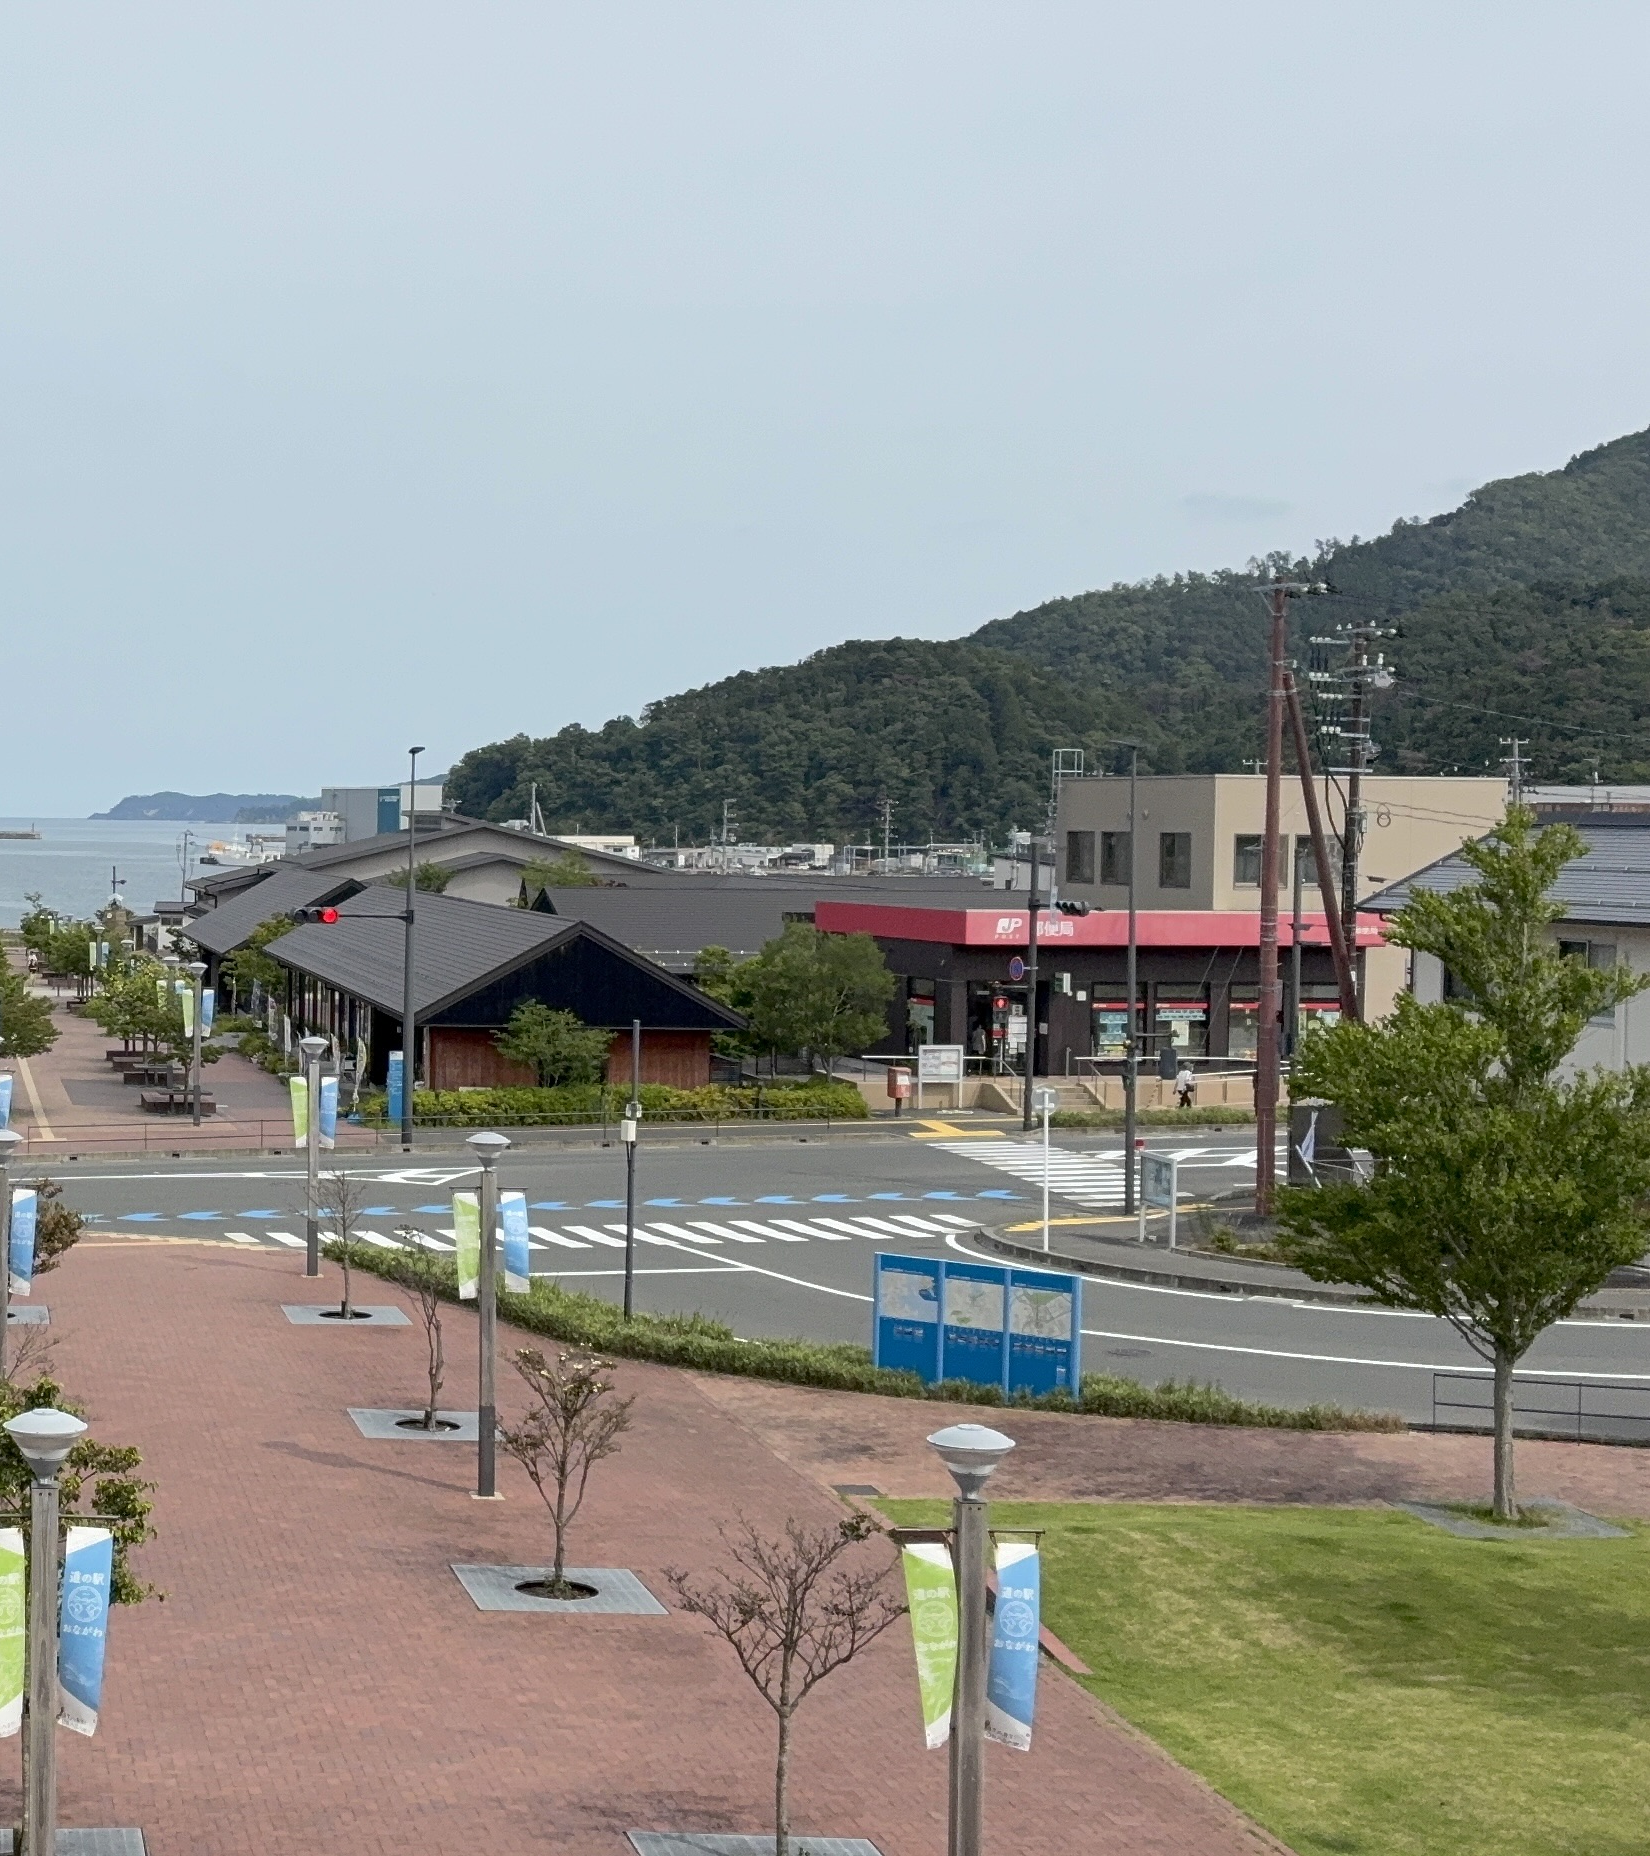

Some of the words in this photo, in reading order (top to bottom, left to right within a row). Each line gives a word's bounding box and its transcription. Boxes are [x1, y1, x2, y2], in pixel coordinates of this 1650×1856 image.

[69, 1571, 105, 1586] 道の駅
[914, 1587, 951, 1600] 道の駅
[1001, 1587, 1035, 1600] 道の駅
[63, 1624, 103, 1638] おながわ
[994, 1639, 1035, 1652] おながわ
